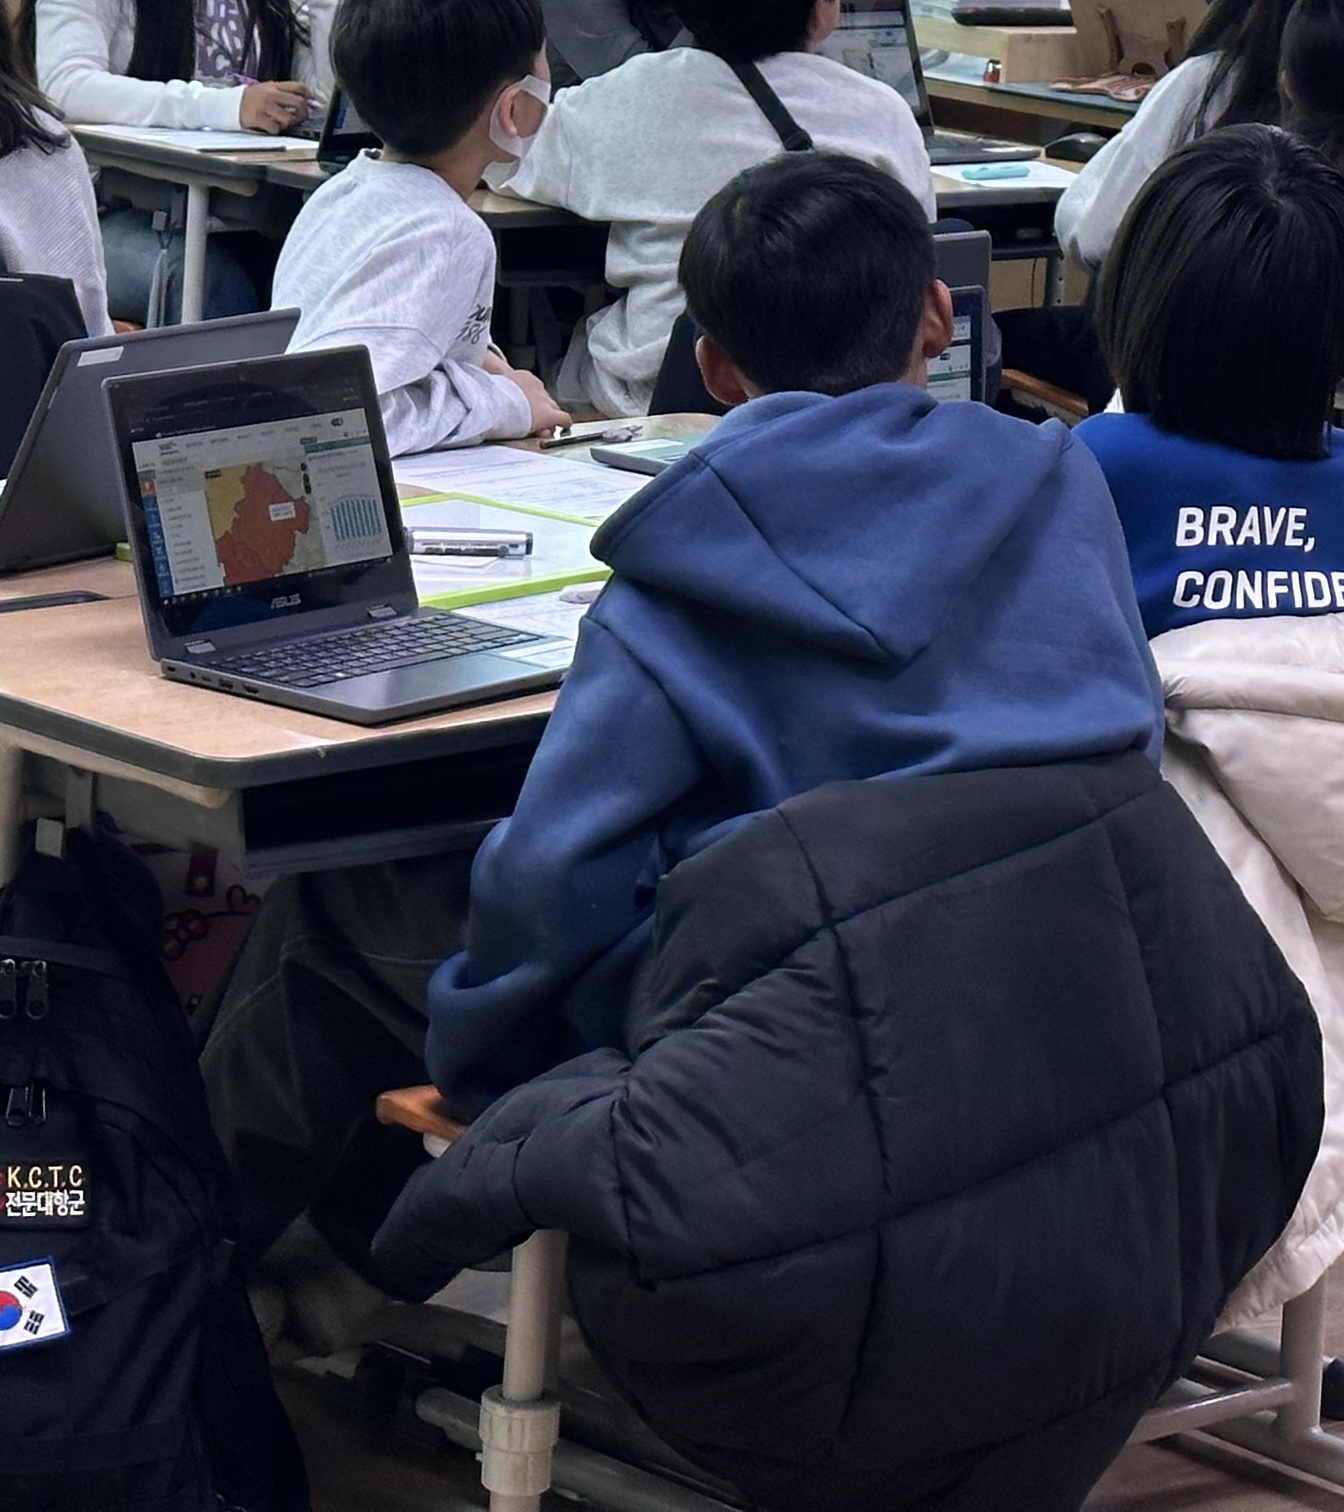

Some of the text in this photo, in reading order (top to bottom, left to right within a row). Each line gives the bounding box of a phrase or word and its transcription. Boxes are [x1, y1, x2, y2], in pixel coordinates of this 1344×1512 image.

[1175, 506, 1315, 552] BRAVE,
[270, 592, 302, 610] ASUS
[5, 1188, 86, 1217] 전문대항군
